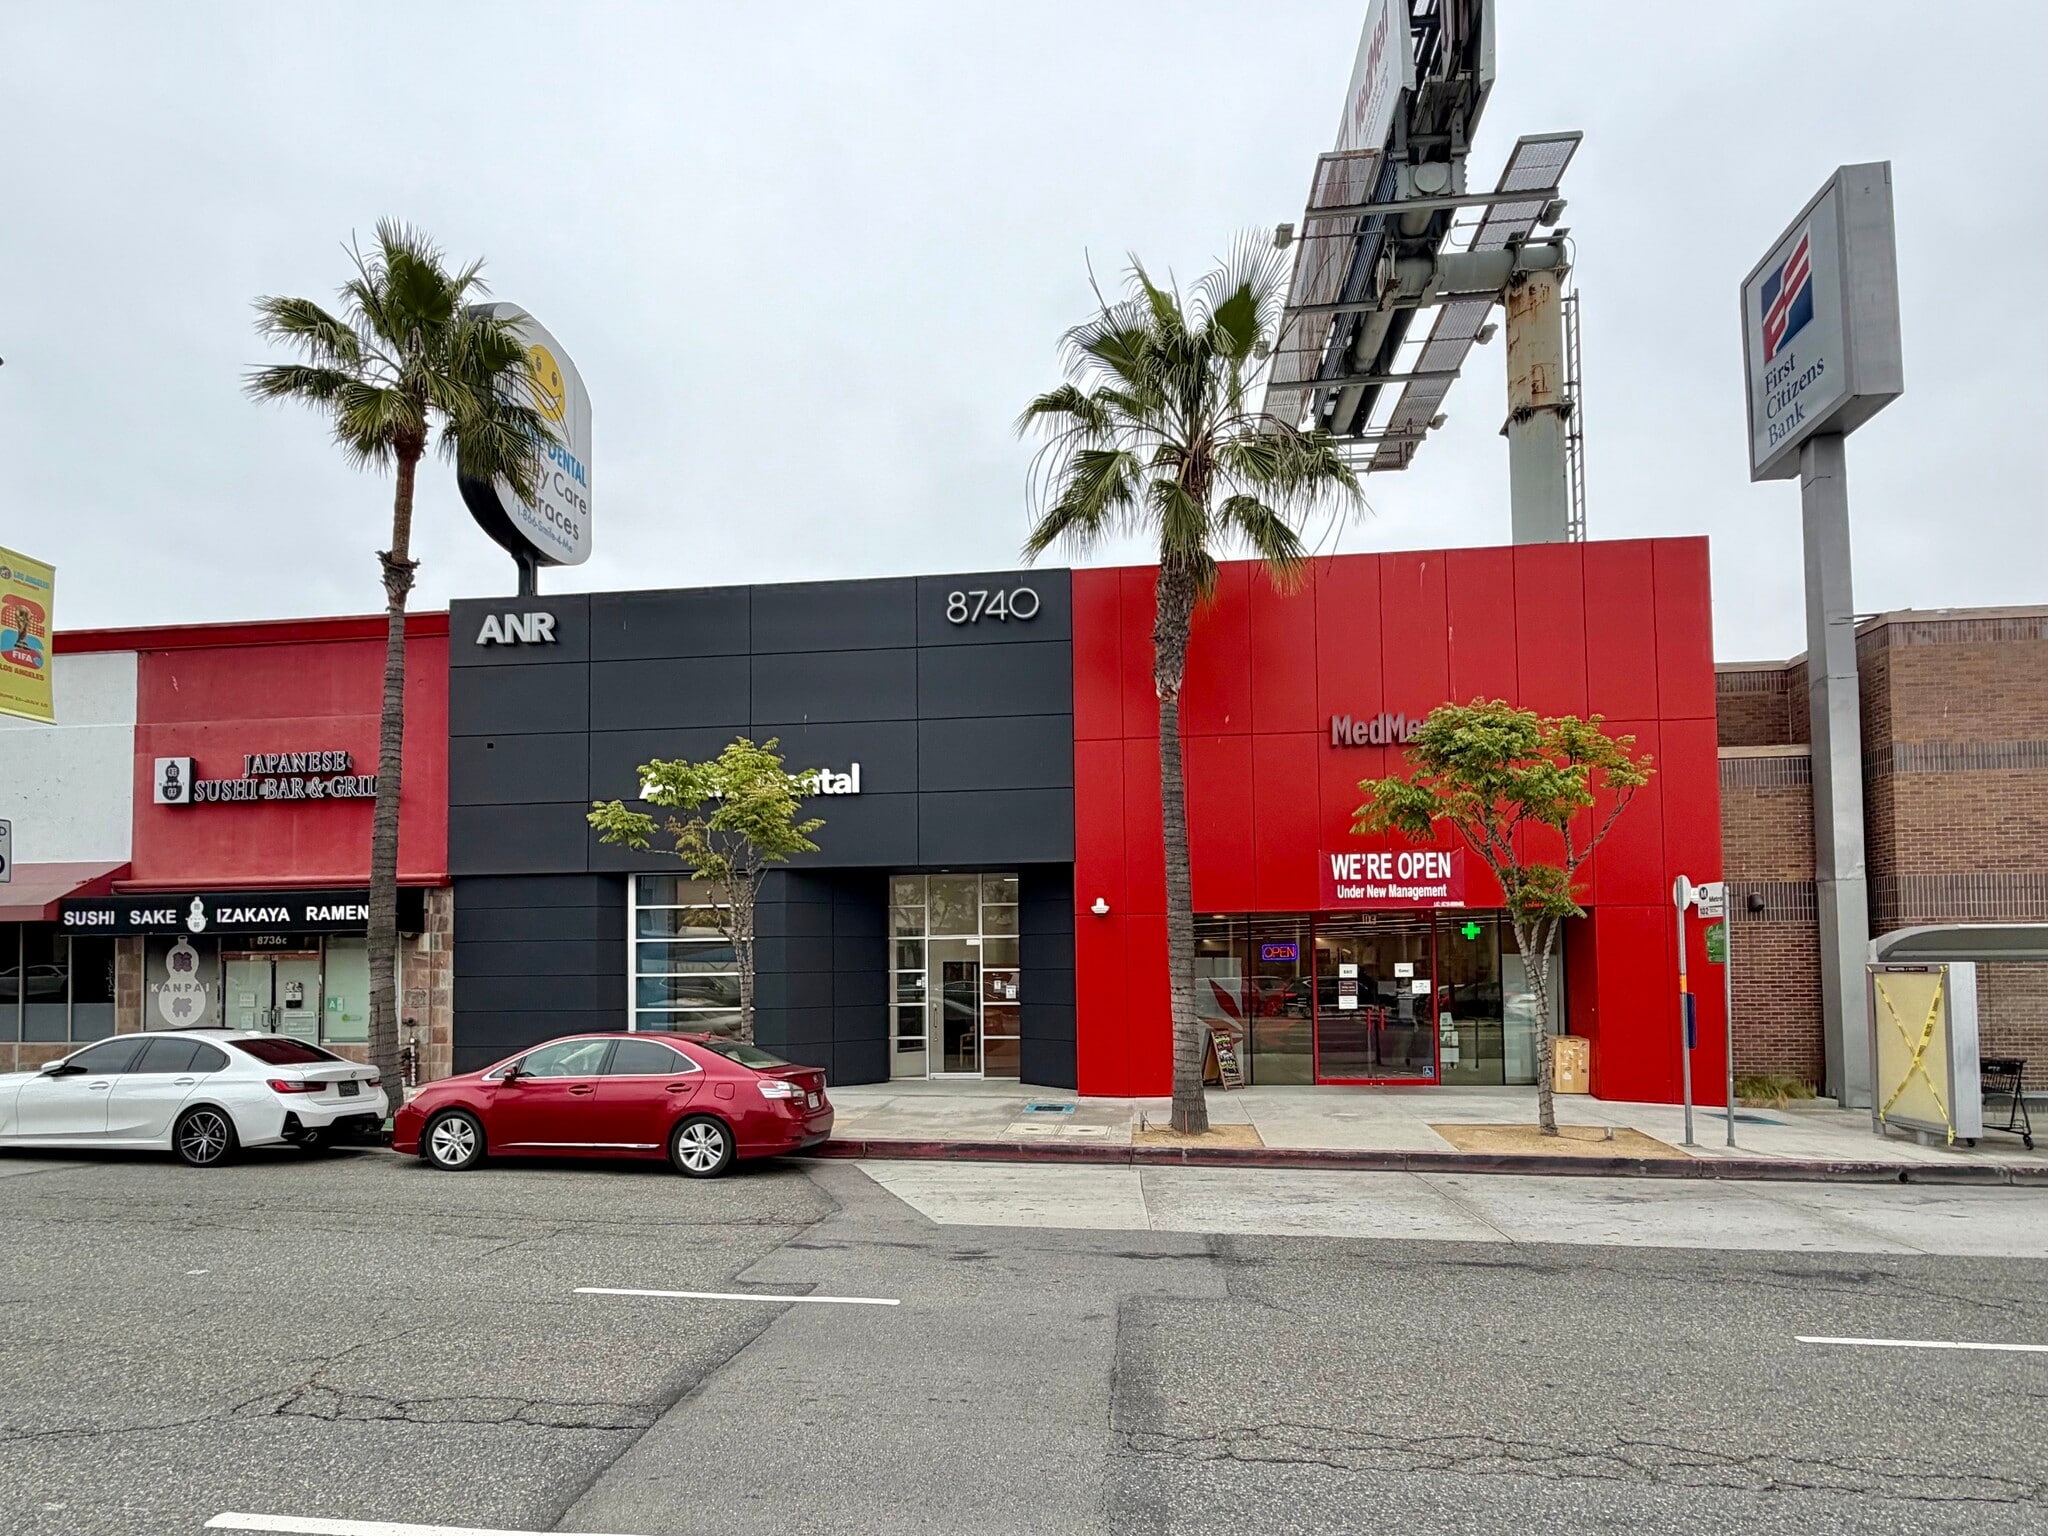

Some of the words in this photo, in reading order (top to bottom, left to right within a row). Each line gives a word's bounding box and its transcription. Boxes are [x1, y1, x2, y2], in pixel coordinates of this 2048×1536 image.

[1764, 352, 1795, 396] First
[1766, 356, 1825, 420] Citizens
[1768, 403, 1806, 448] Bank
[553, 471, 587, 515] Care
[537, 497, 579, 541] races
[946, 587, 1039, 625] 8740
[476, 612, 556, 645] ANR
[12, 650, 33, 664] FIFA
[14, 667, 45, 682] ANGELES
[1331, 712, 1424, 746] MedMe
[242, 751, 347, 778] JAPANESE
[194, 778, 258, 801] SUSHI
[264, 778, 305, 799] BAR
[308, 776, 325, 799] &
[1331, 853, 1393, 881] WE'RE
[1397, 851, 1452, 879] OPEN
[1337, 884, 1365, 898] Under
[1366, 884, 1387, 898] New
[1388, 883, 1447, 900] Management
[63, 911, 115, 926] SUSHI
[129, 909, 177, 925] SAKE
[216, 907, 291, 923] IZAKAYA
[305, 905, 369, 920] RAMEN
[257, 935, 287, 945] 8736c
[1264, 946, 1295, 958] OPEN
[151, 983, 210, 993] KANPAI
